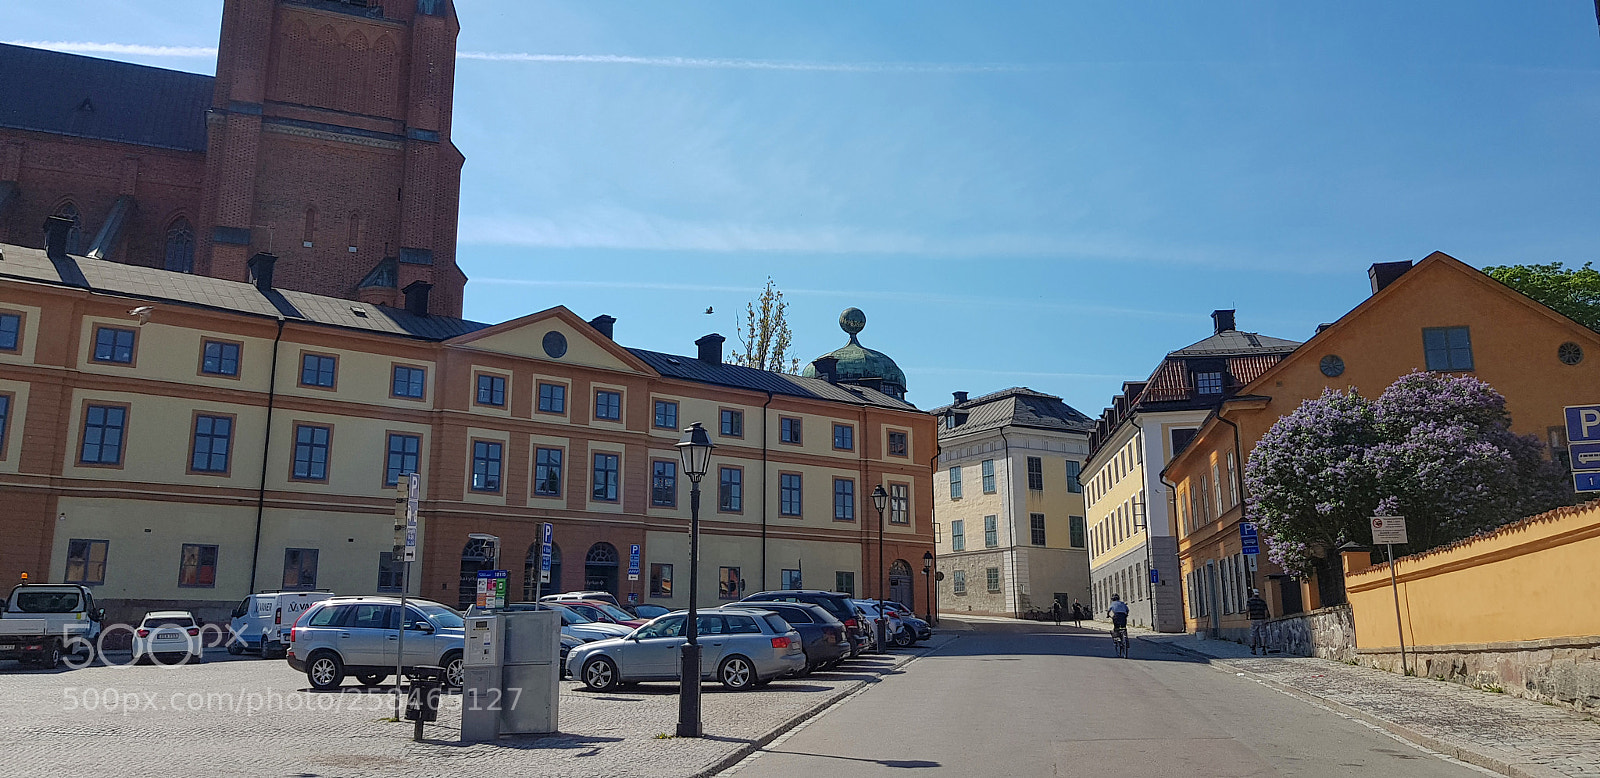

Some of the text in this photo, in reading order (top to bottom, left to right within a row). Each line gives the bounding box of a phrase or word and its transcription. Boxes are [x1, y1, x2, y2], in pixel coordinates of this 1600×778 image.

[1580, 409, 1600, 438] P
[411, 476, 418, 497] P
[1589, 477, 1594, 486] 1
[544, 525, 552, 542] P
[1244, 523, 1253, 535] P
[632, 545, 639, 554] P
